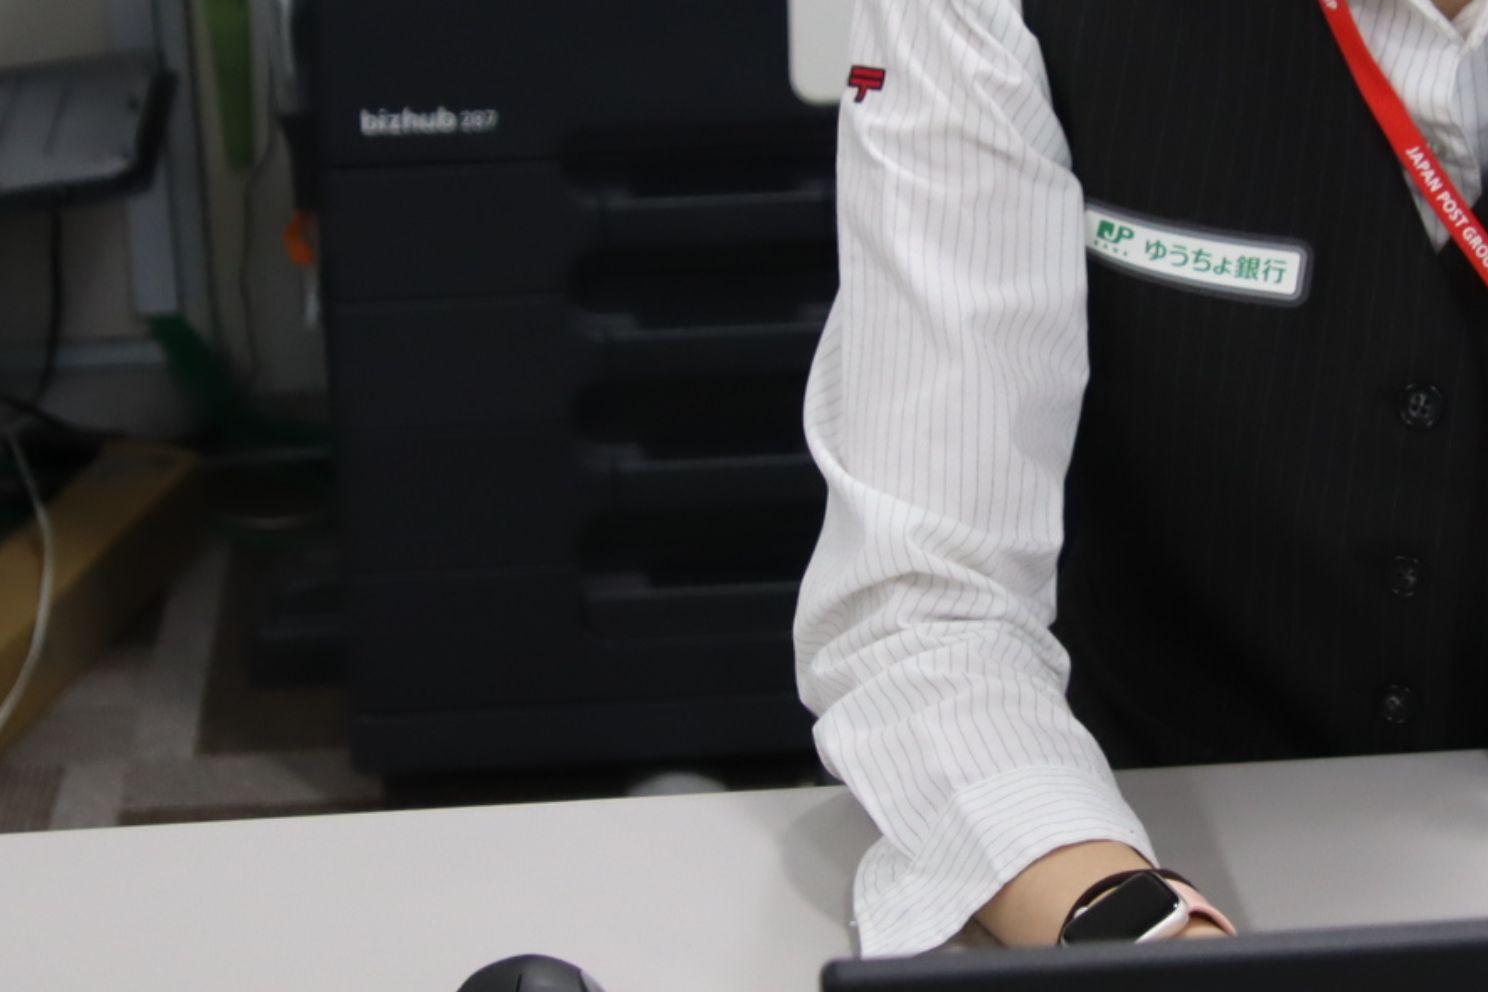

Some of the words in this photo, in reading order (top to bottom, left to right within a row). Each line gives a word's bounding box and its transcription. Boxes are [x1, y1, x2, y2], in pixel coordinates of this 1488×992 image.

[360, 105, 457, 136] bizhub
[1405, 145, 1443, 192] JAPAN
[1436, 190, 1470, 227] POST
[1096, 219, 1135, 244] JP
[1144, 239, 1288, 285] ゆうちょ銀行
